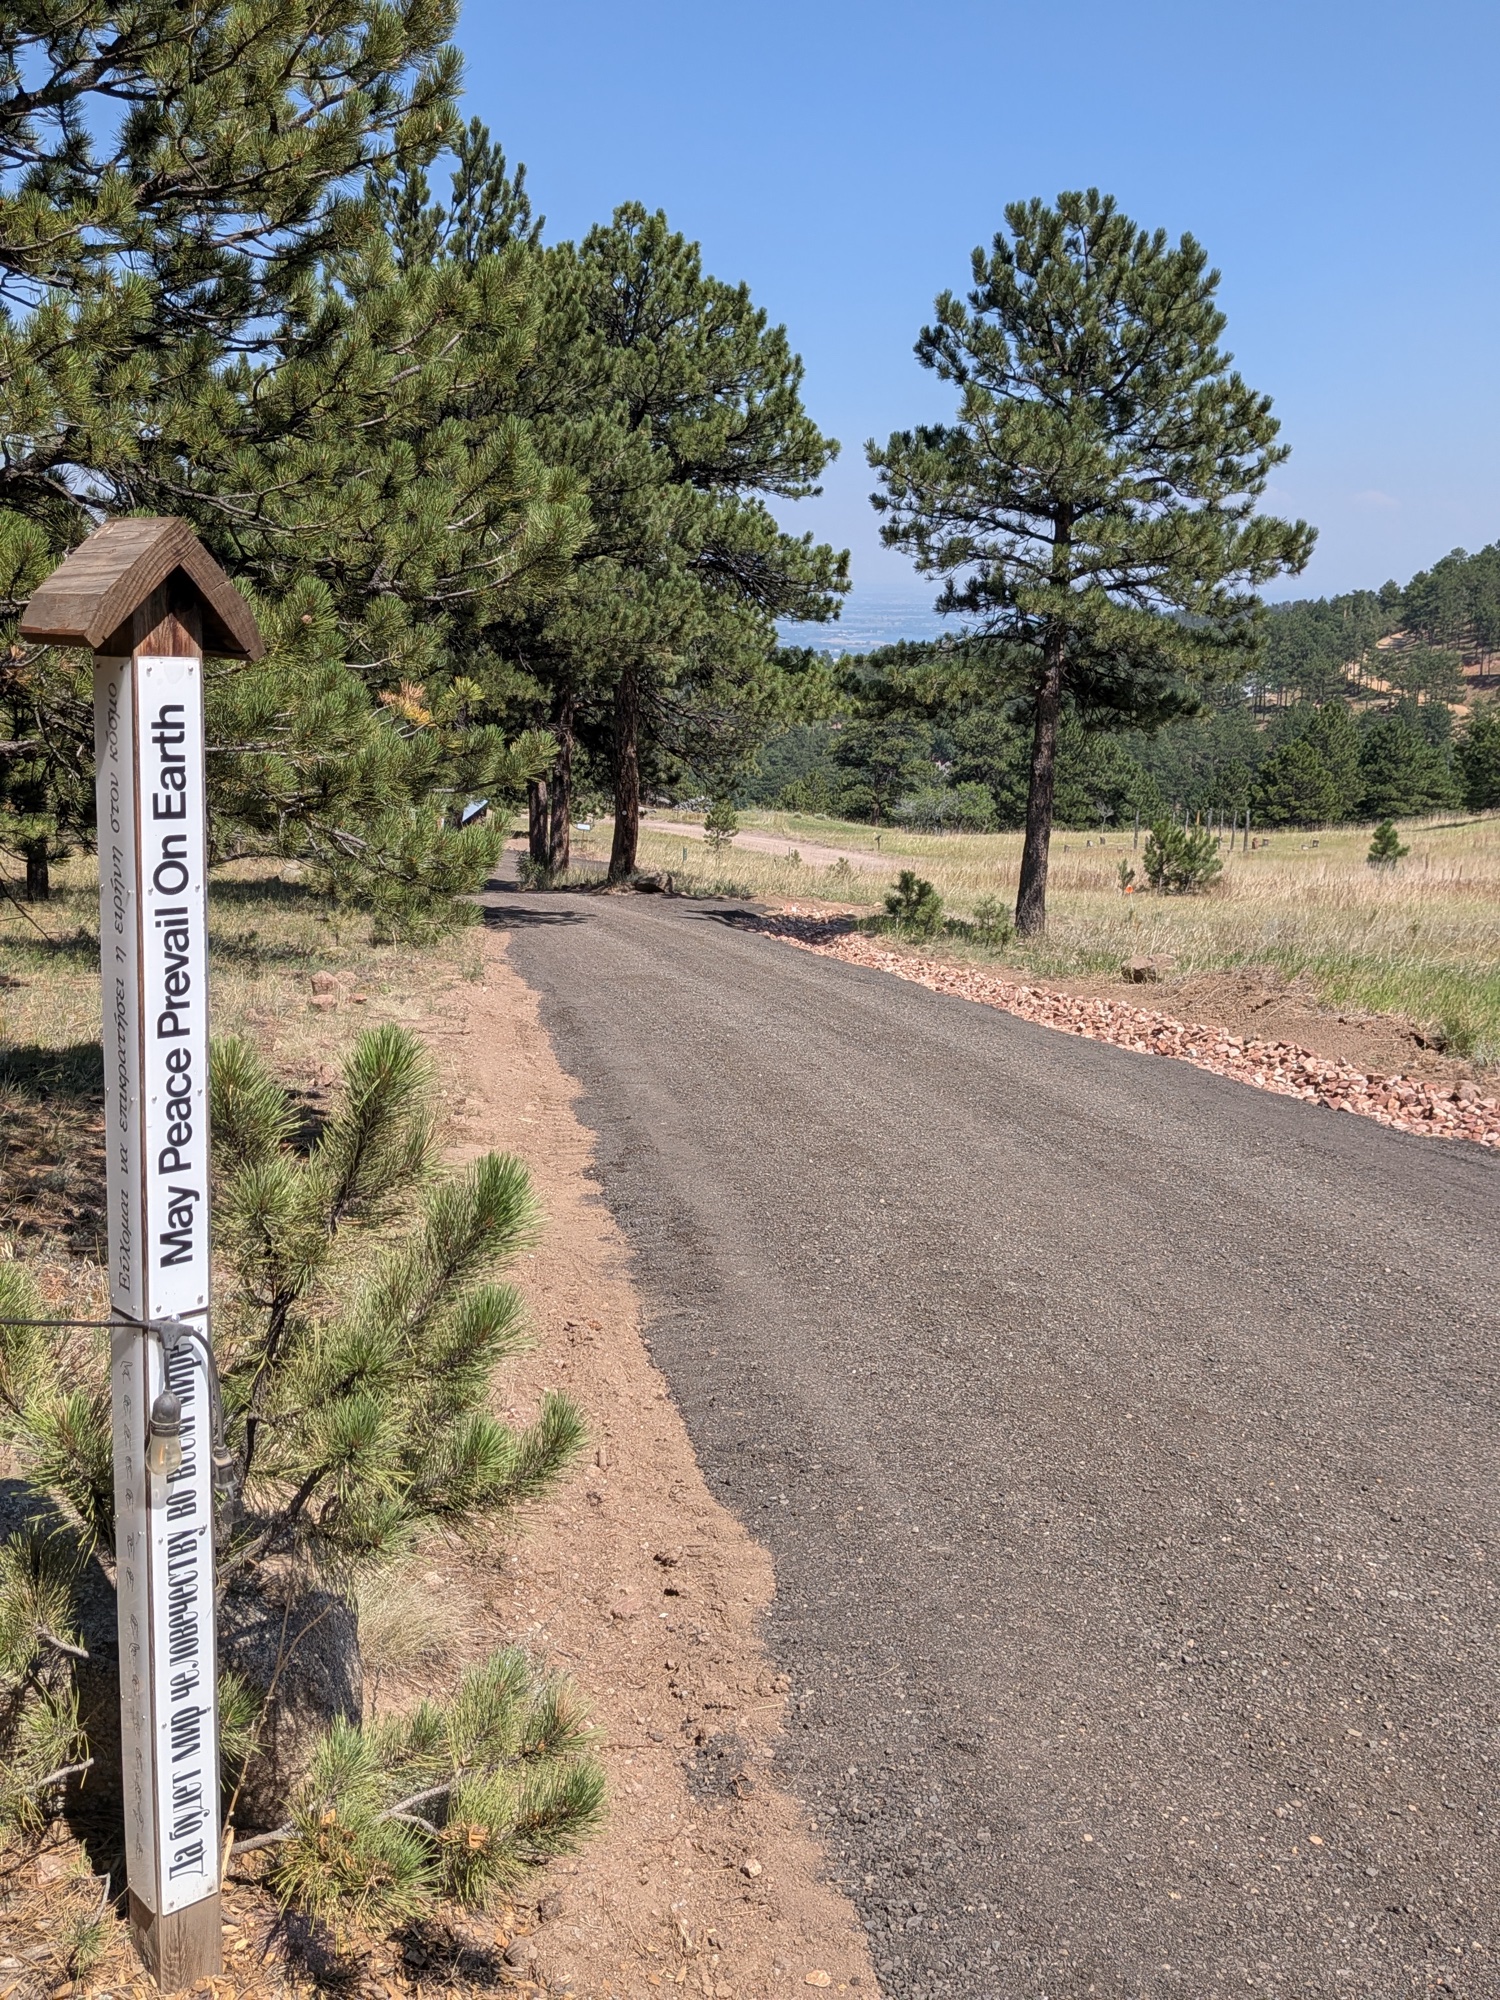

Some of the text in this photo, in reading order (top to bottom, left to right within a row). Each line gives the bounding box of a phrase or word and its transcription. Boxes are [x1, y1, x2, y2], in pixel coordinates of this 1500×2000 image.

[105, 682, 121, 762] κόσμο
[110, 772, 120, 833] στον
[110, 845, 125, 935] ειρήνη
[115, 945, 127, 964] η
[151, 704, 200, 1268] May Peace Prevail On Earth
[113, 977, 130, 1132] επικρατήσει
[119, 1142, 130, 1175] να
[166, 1489, 198, 1522] во
[166, 1524, 207, 1703] человечеству
[170, 1705, 210, 1763] мир
[168, 1768, 211, 1841] будет
[168, 1838, 209, 1881] Да
